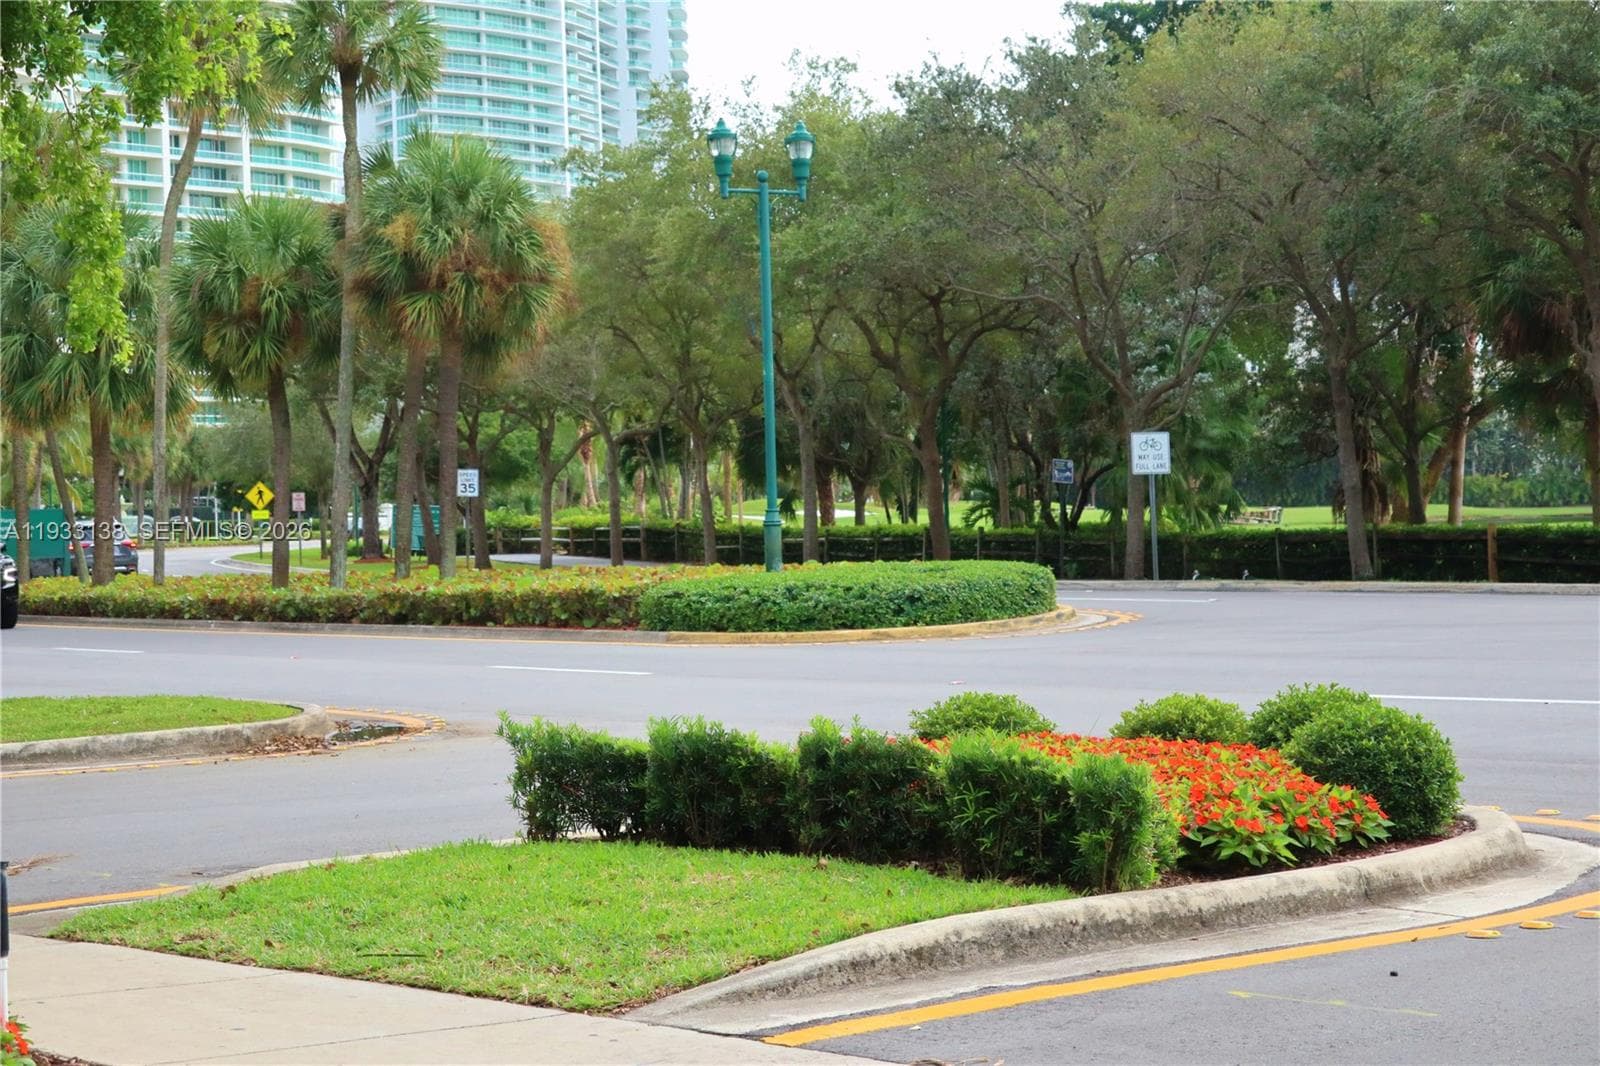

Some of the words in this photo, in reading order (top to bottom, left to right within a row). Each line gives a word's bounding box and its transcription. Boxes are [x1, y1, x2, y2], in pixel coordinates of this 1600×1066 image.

[1153, 453, 1164, 461] USE
[1153, 462, 1167, 470] LANE
[460, 483, 476, 493] 35
